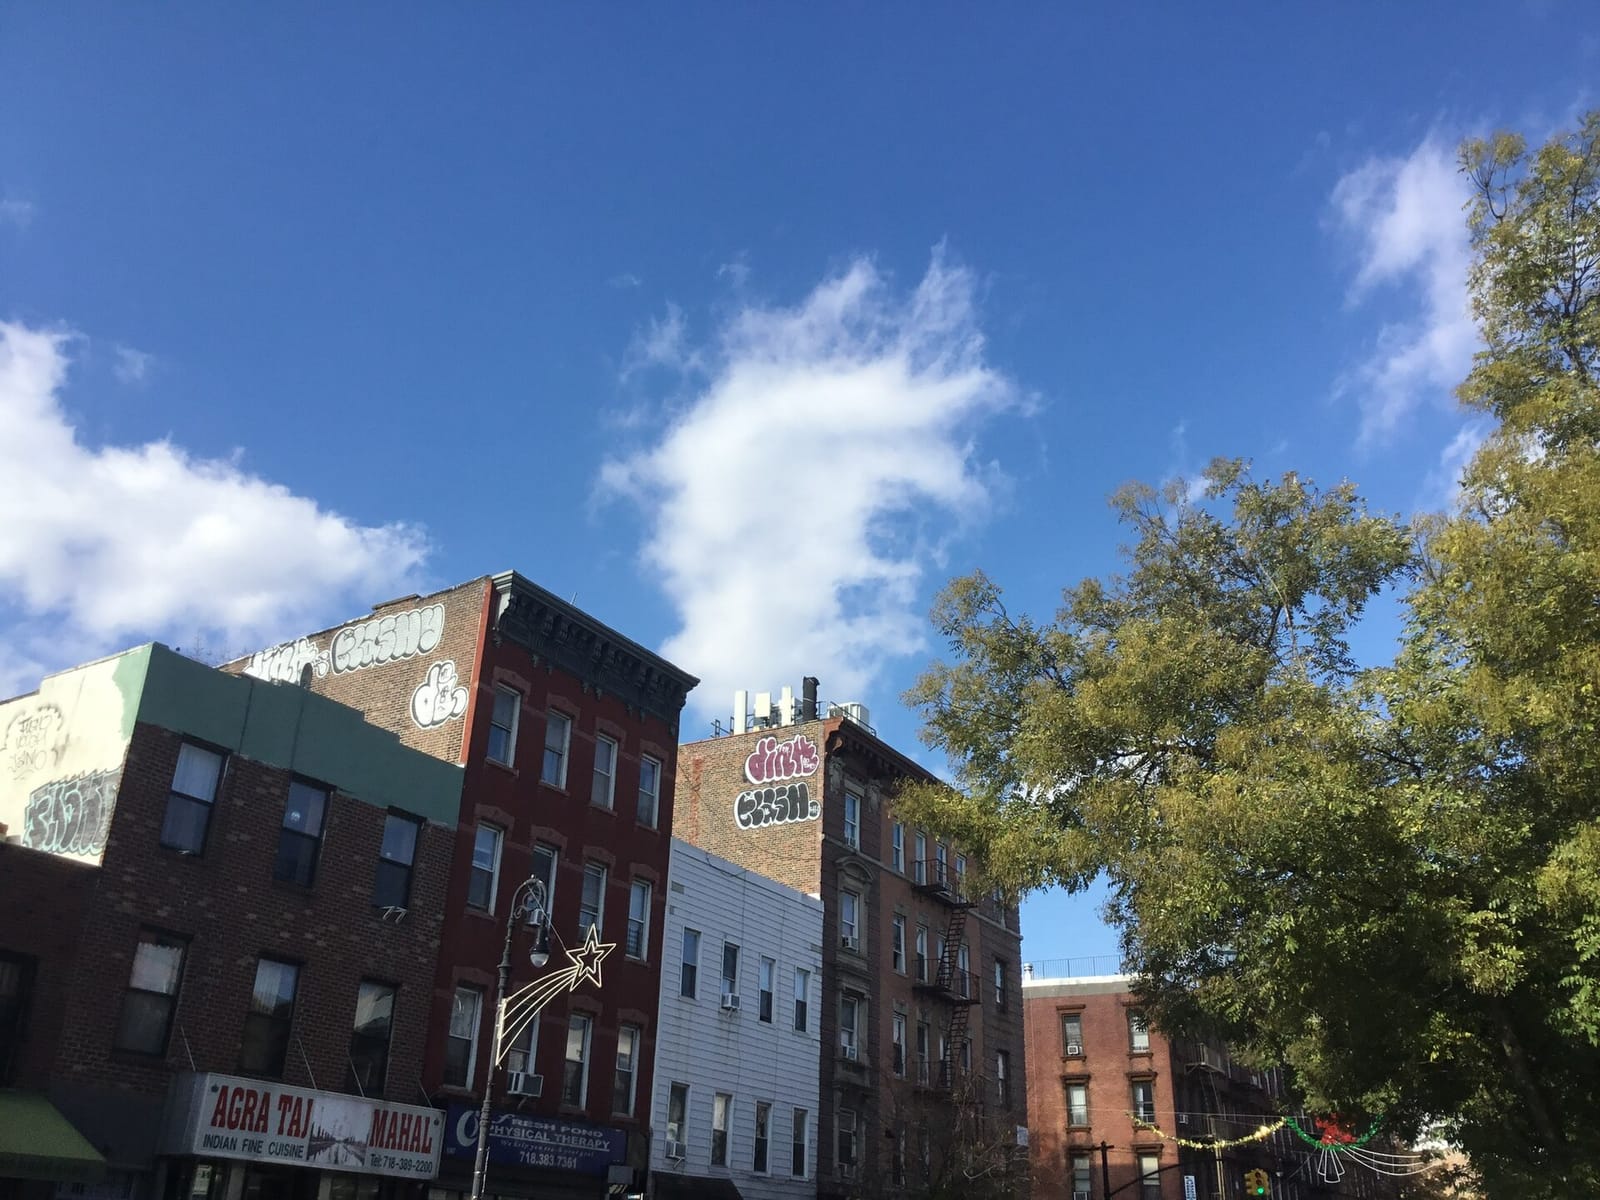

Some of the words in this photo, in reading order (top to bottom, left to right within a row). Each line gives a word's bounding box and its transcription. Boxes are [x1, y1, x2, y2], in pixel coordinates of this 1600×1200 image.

[210, 1085, 271, 1134] AGRA
[277, 1094, 314, 1139] TAJ
[369, 1109, 432, 1154] MAHAL
[554, 1134, 610, 1150] THERAPY
[560, 1125, 603, 1139] POND
[203, 1134, 238, 1151] INDIAN
[241, 1138, 263, 1154] FINE
[268, 1142, 304, 1159] CUISINE
